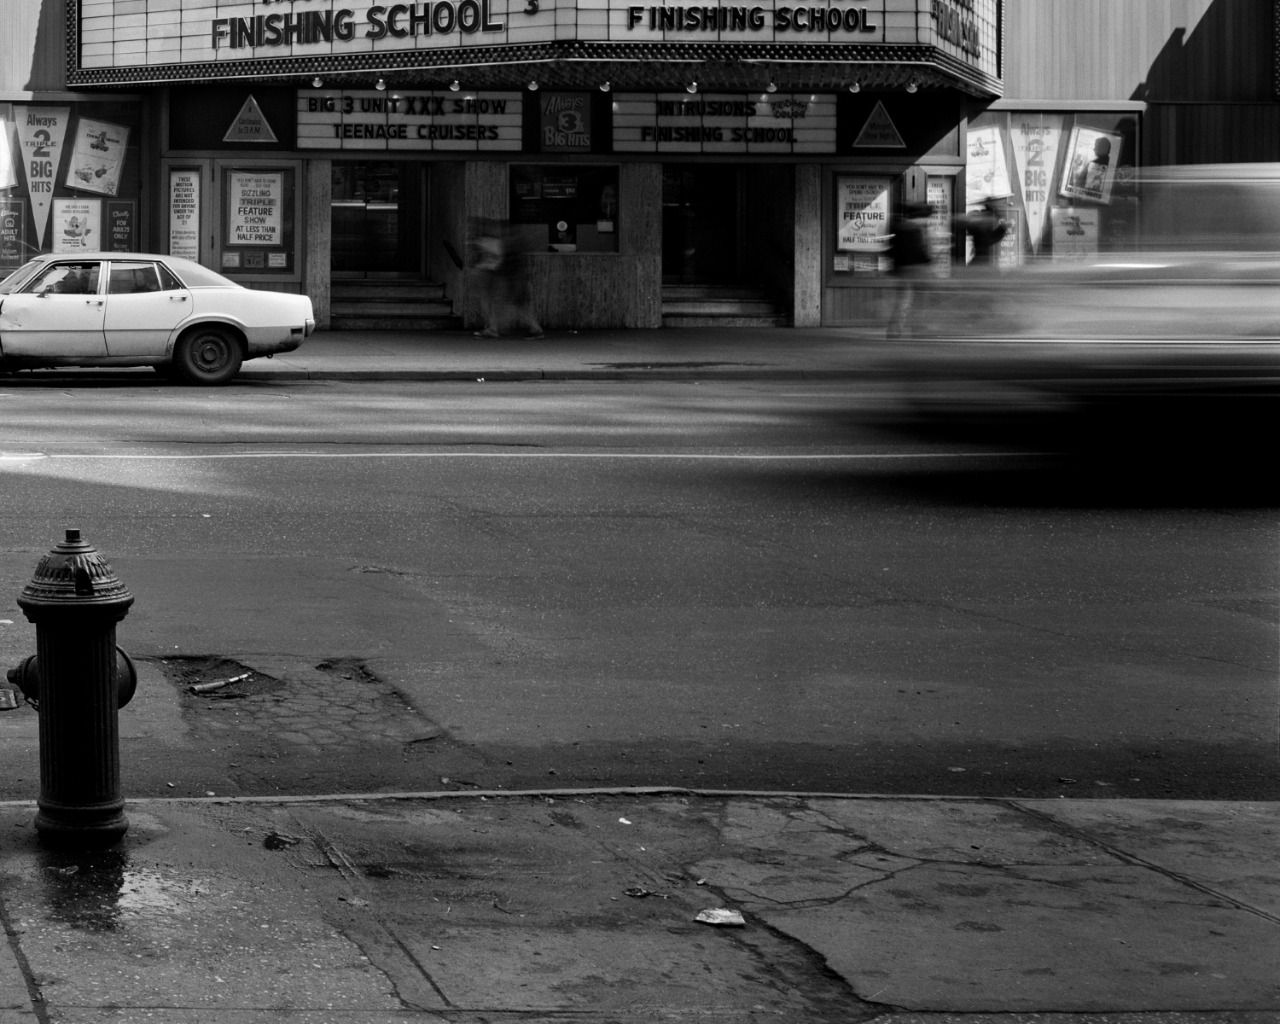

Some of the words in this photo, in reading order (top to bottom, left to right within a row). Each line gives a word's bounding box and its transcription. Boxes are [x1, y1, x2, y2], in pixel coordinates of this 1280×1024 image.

[628, 5, 766, 32] FINISHING
[775, 6, 877, 33] SCHOOL
[211, 7, 356, 50] FINISHING
[308, 97, 336, 113] BIG
[342, 95, 355, 114] 3
[361, 97, 401, 114] UNIT
[453, 99, 507, 114] SHOW
[656, 101, 757, 117] INTRUSIONS
[26, 113, 57, 127] Always
[333, 123, 409, 140] TEENAGE
[416, 125, 500, 140] CRUISERS
[641, 127, 724, 142] FINISHING
[731, 127, 798, 143] SCHOOL
[33, 129, 51, 158] 2
[1027, 138, 1045, 167] 2
[30, 160, 53, 178] BIG
[1025, 169, 1047, 187] BIG
[31, 180, 52, 193] HITS
[1025, 190, 1046, 202] HITS
[238, 207, 273, 216] FEATURE
[843, 212, 885, 221] FEATURE
[243, 216, 266, 224] SHOW
[235, 225, 244, 233] AT
[246, 225, 259, 233] LESS
[237, 233, 254, 241] HALF
[255, 234, 273, 242] PRICE
